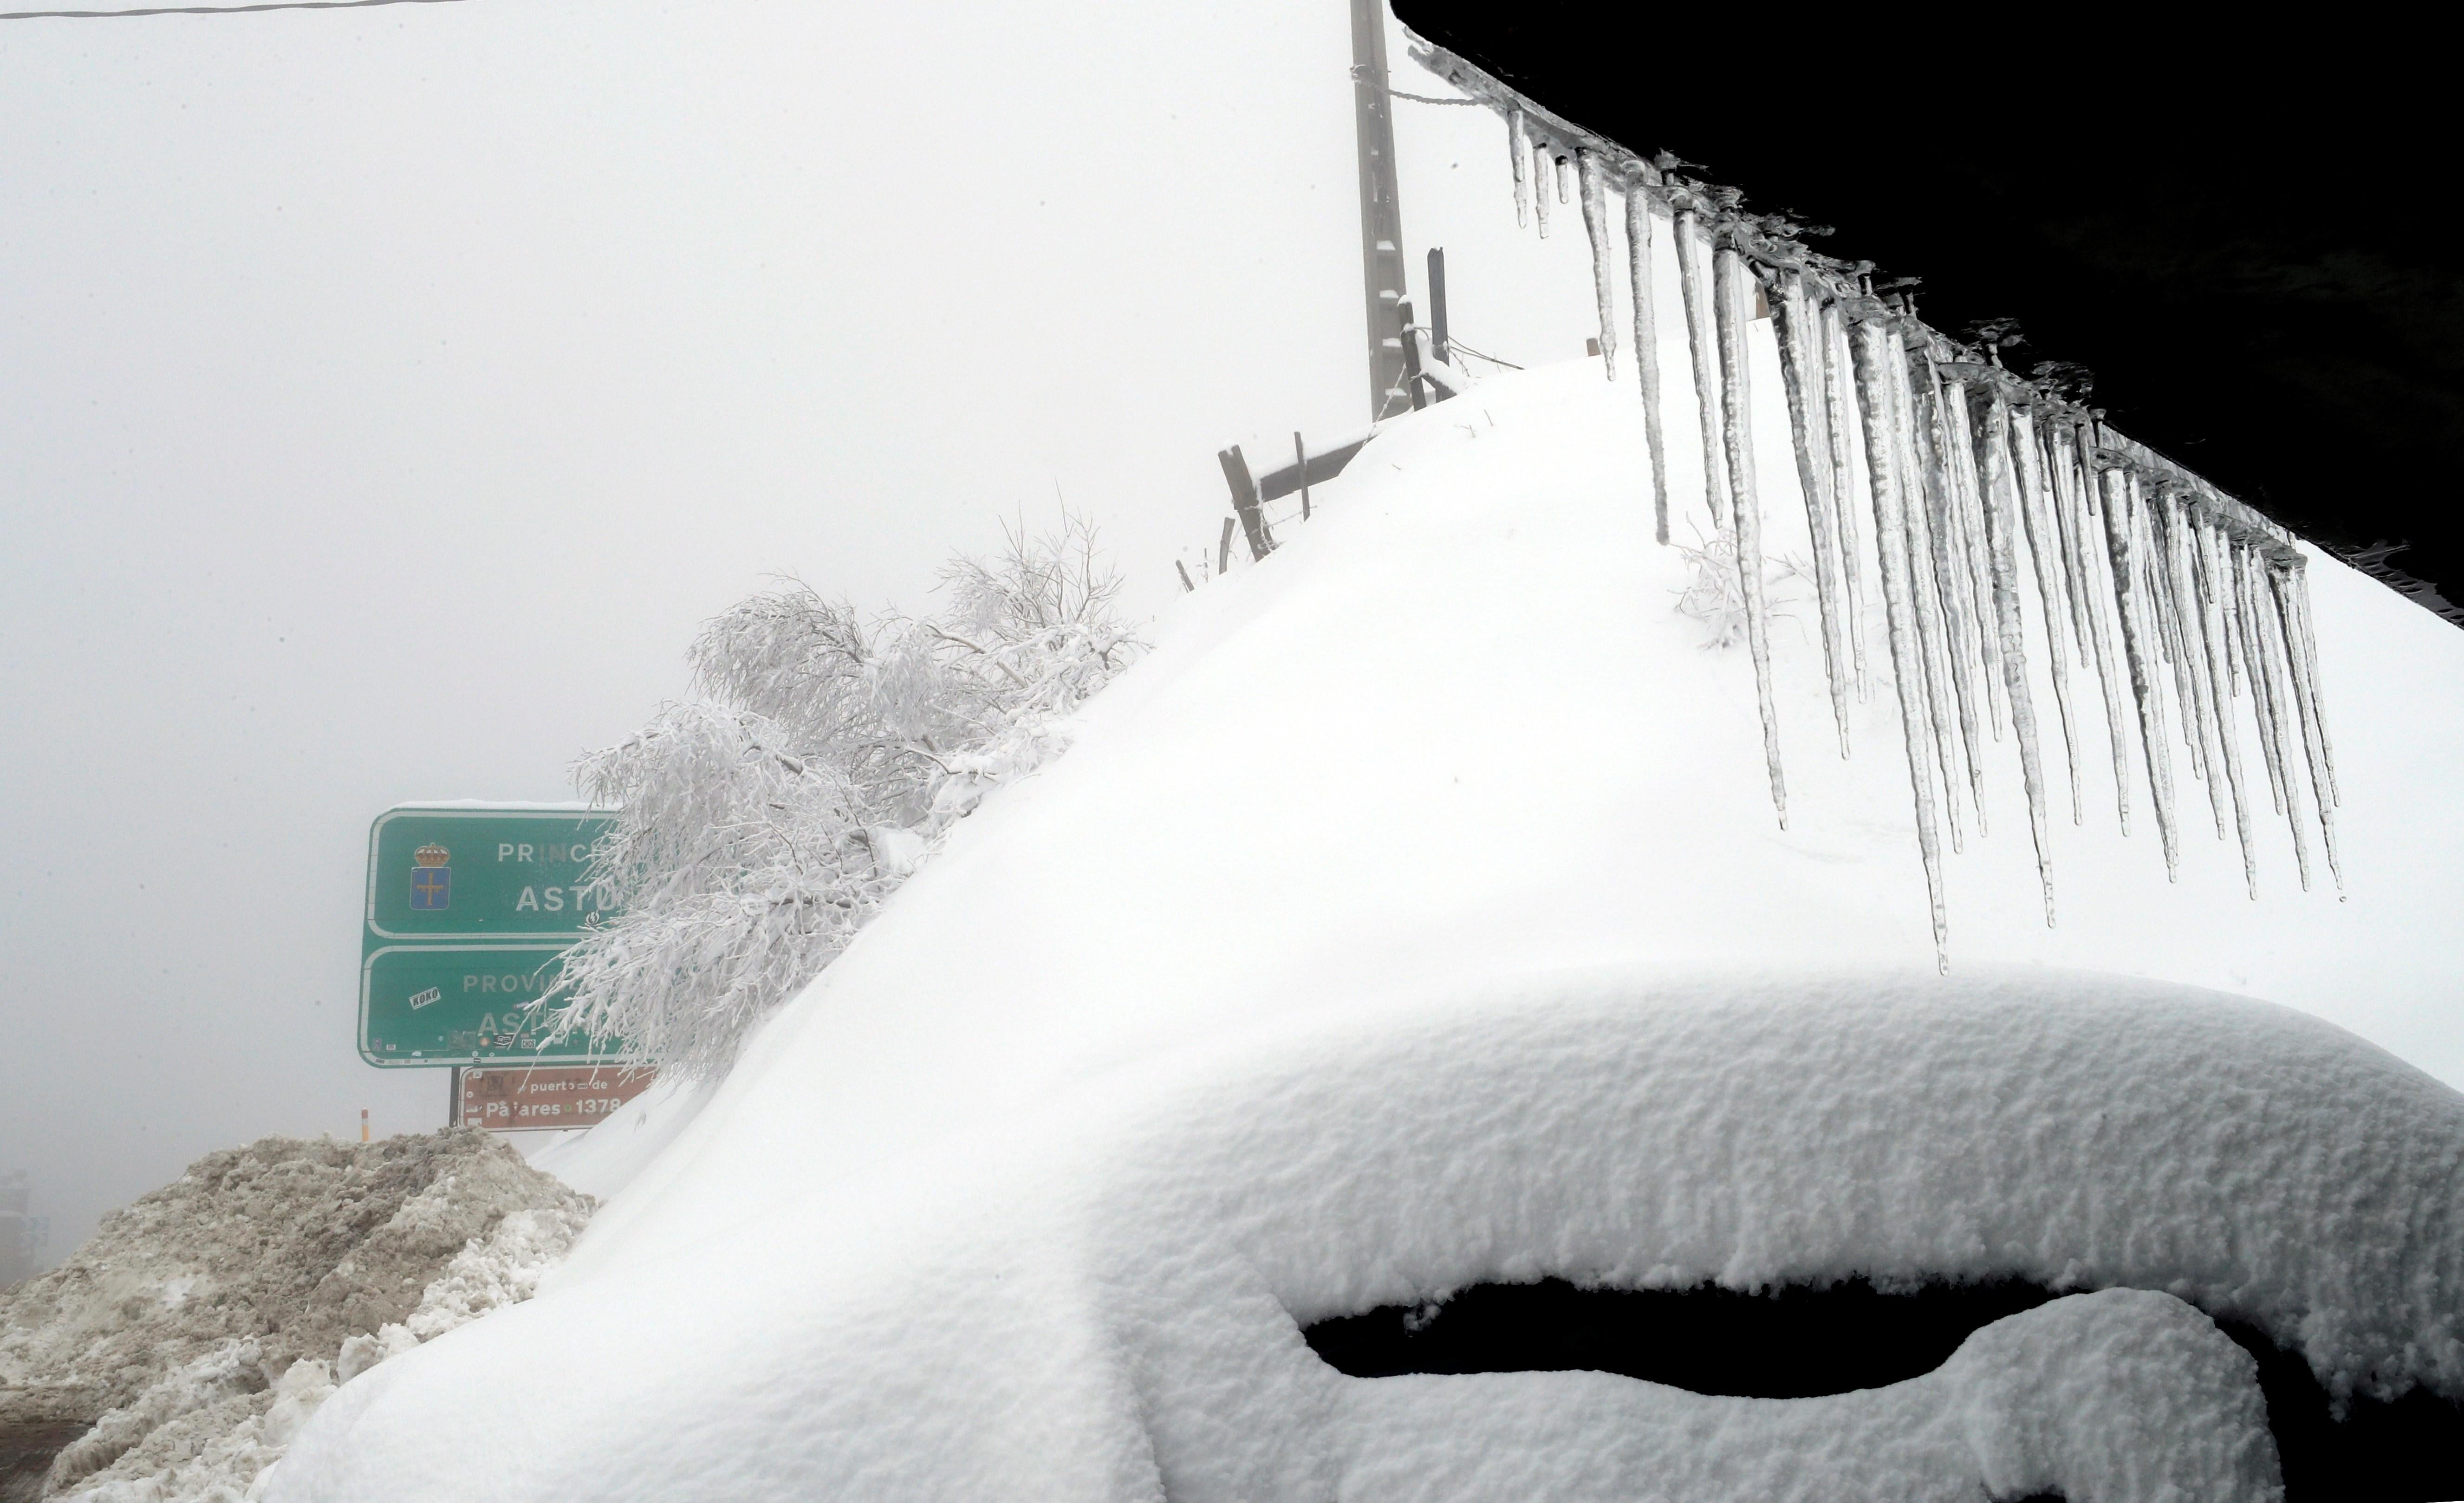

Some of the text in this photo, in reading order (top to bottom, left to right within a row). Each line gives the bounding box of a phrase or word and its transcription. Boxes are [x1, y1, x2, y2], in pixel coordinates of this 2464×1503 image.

[413, 989, 439, 1007] KOKO
[531, 1080, 608, 1094] puerto de
[576, 1098, 621, 1114] 1378
